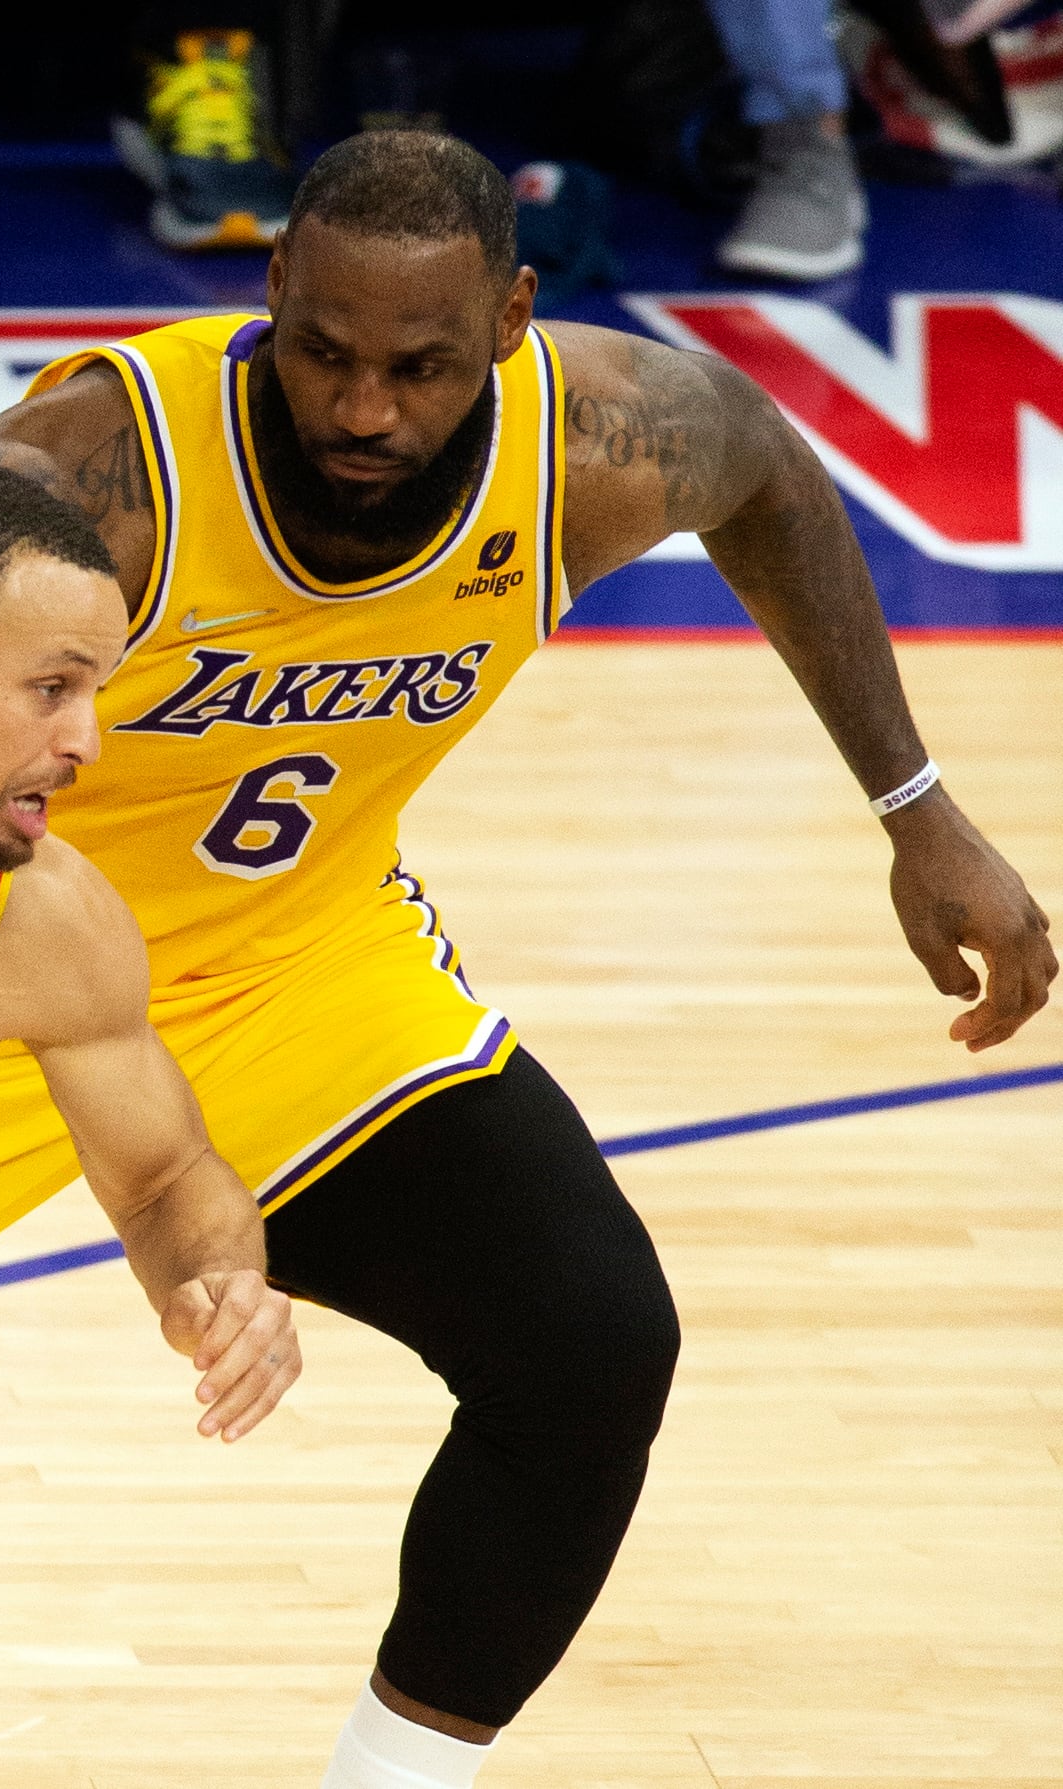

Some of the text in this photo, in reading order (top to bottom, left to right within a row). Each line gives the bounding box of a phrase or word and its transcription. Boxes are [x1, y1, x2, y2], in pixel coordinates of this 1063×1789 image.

[454, 570, 523, 600] bibigo
[107, 642, 495, 738] LAKERS
[192, 752, 341, 881] 6
